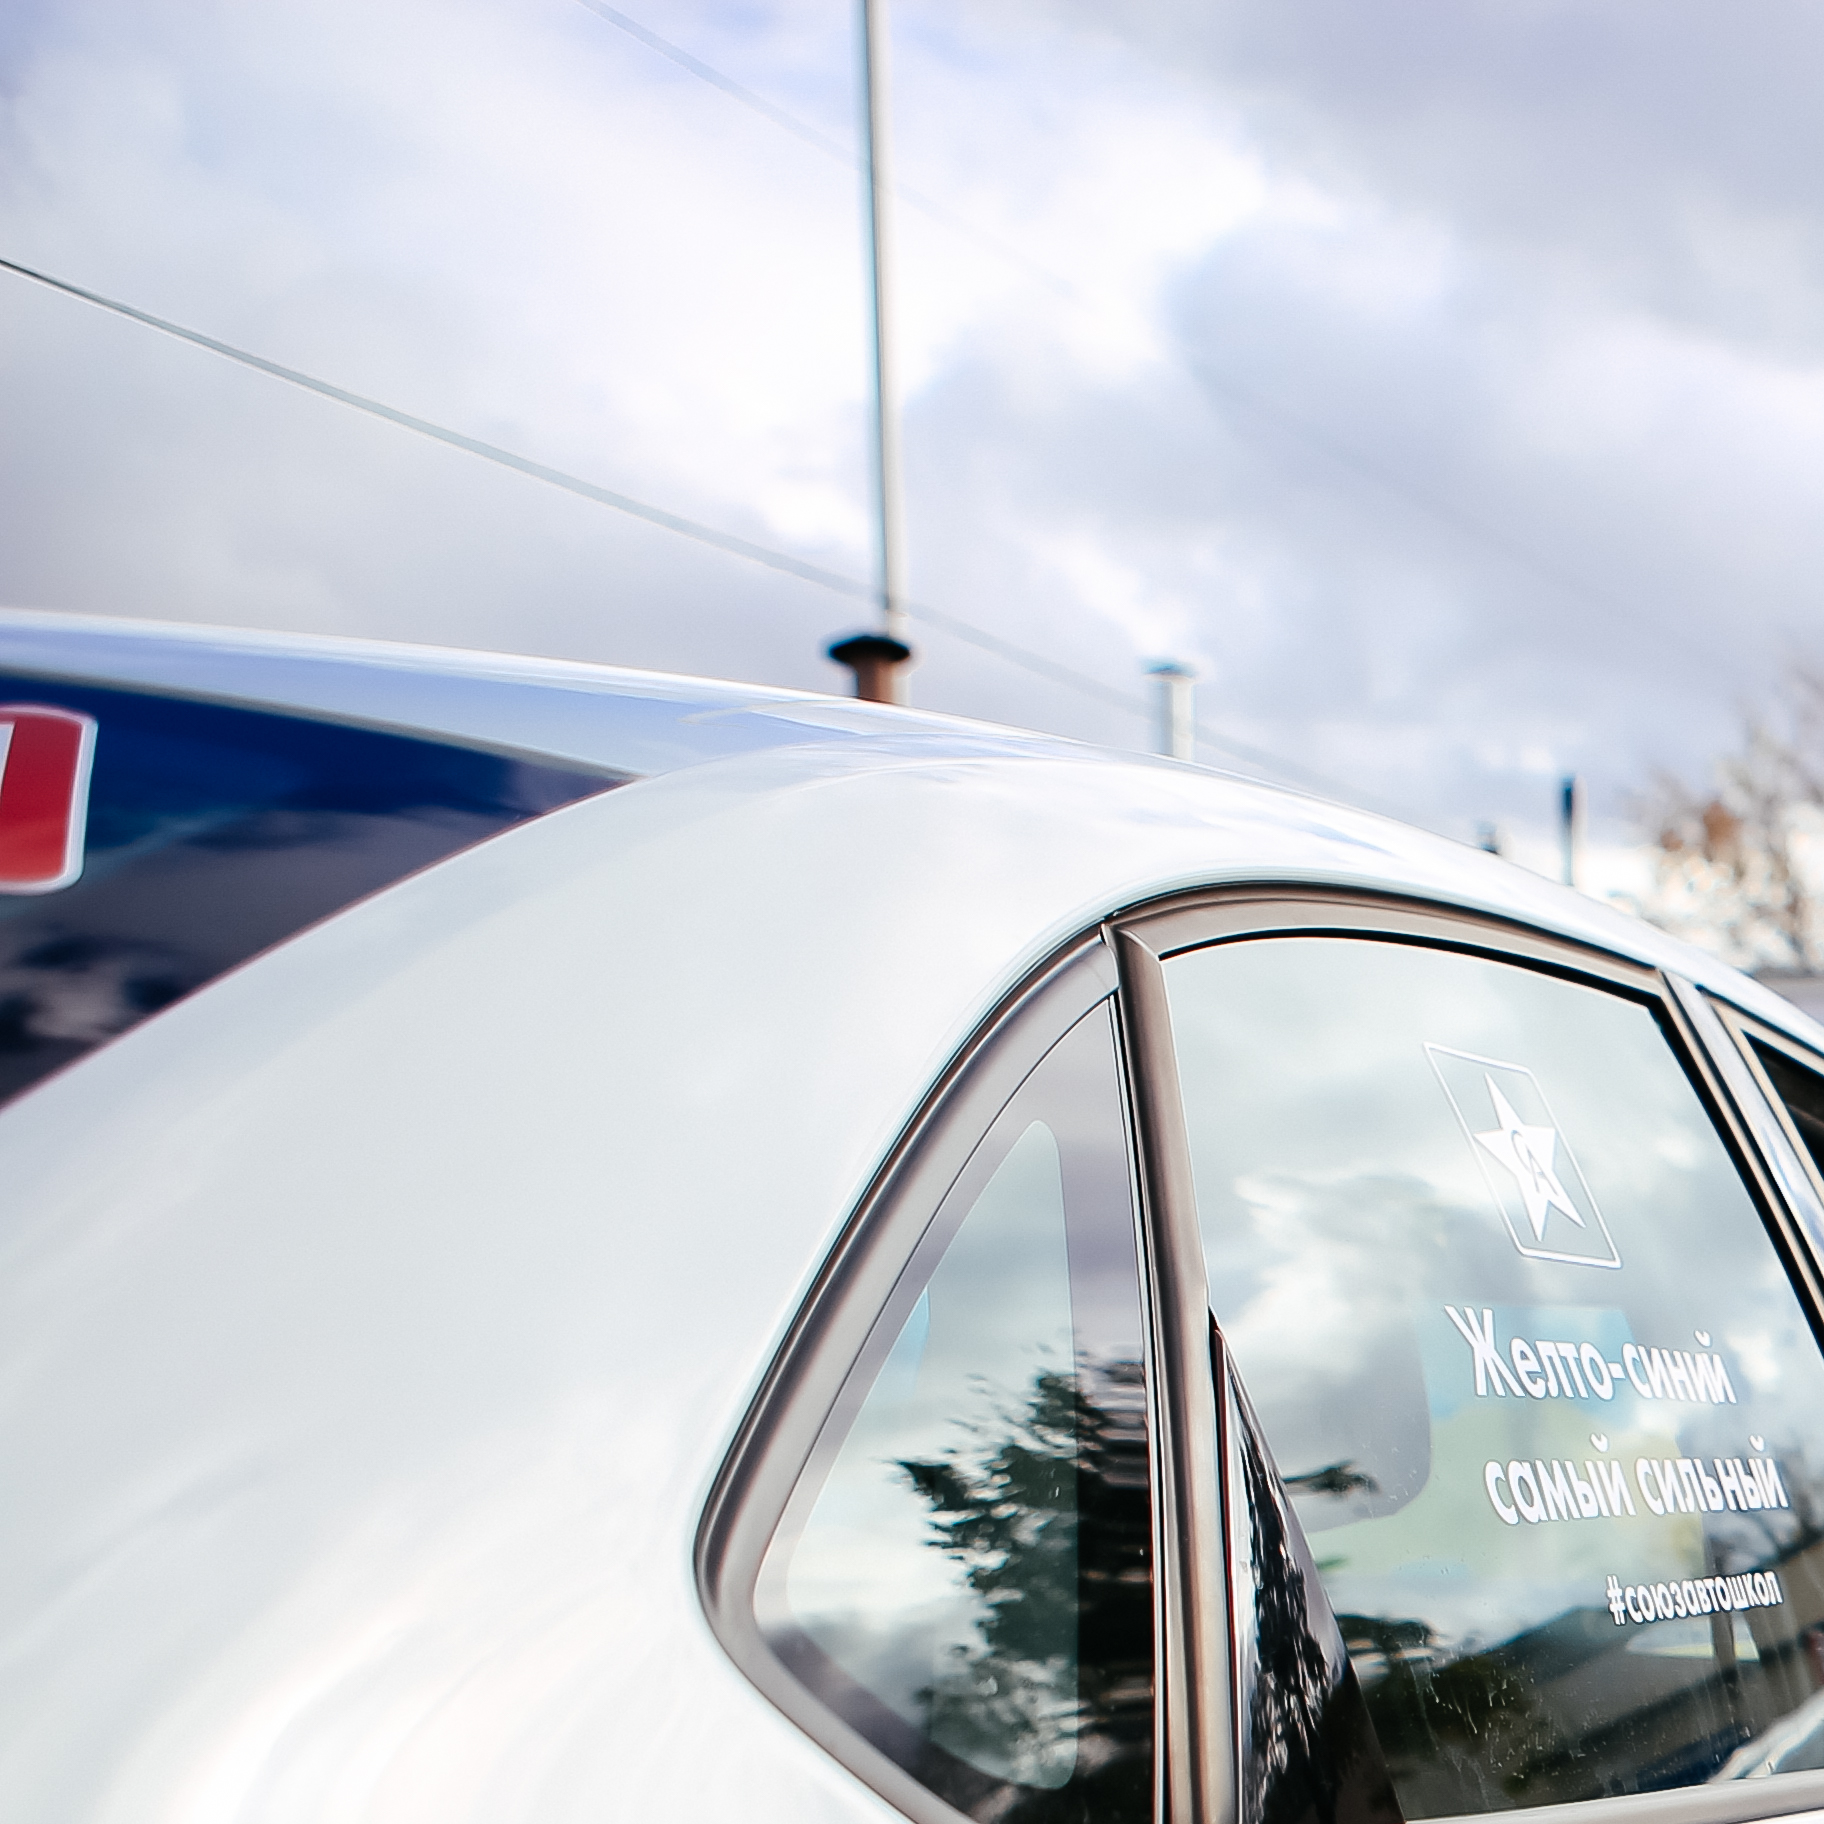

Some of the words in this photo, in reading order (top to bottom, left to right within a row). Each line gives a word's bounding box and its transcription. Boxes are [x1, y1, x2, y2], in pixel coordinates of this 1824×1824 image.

[1444, 1304, 1737, 1405] Желто-синий
[1484, 1433, 1637, 1525] самый
[1635, 1436, 1789, 1509] сильный
[1606, 1570, 1783, 1625] #союзавтошкол
